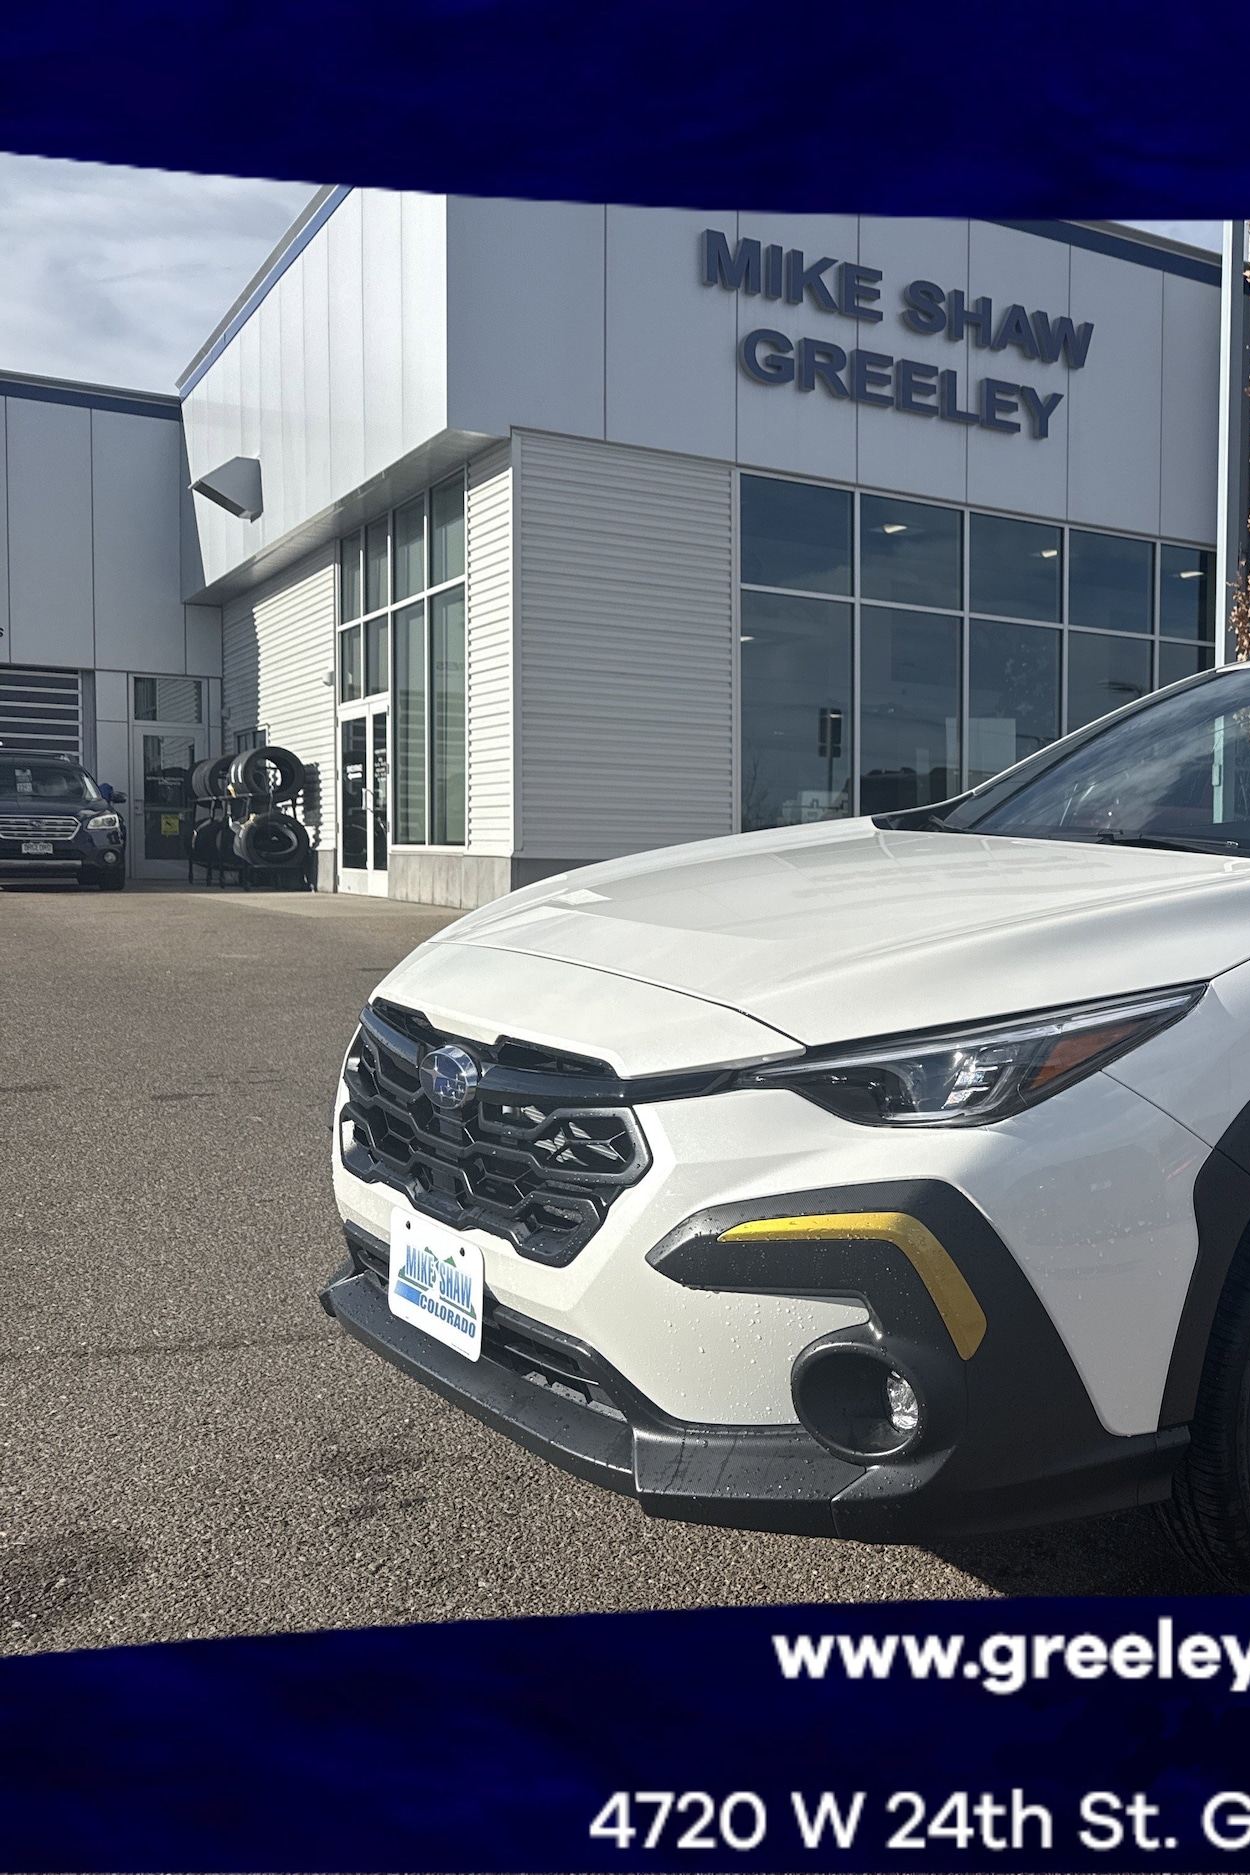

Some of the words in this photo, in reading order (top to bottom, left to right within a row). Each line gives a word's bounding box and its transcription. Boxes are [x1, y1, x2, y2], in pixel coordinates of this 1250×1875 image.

[702, 228, 883, 322] MIKE
[902, 280, 1094, 369] SHAW
[740, 329, 1064, 439] GREELEY
[405, 1244, 433, 1289] MIKE
[438, 1261, 473, 1309] SHAW
[419, 1294, 477, 1339] COLORADO
